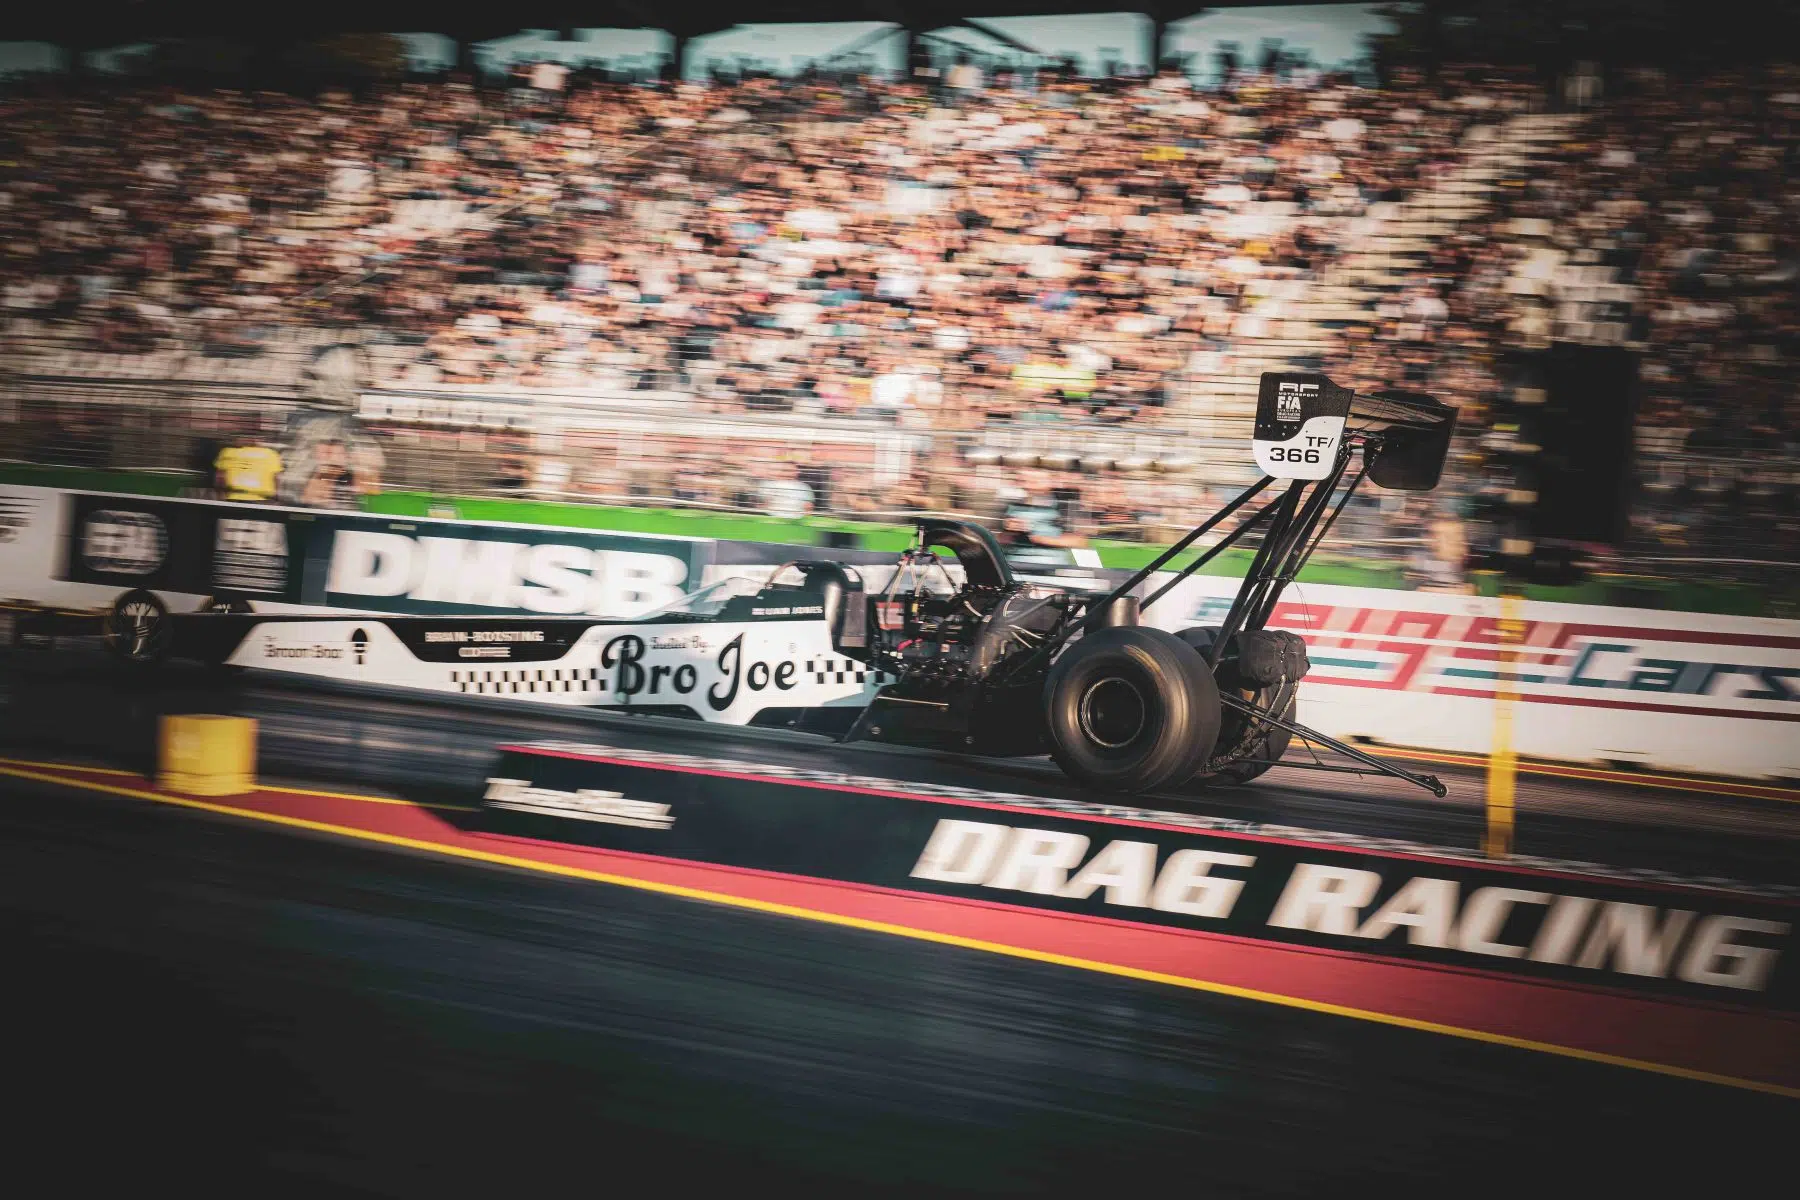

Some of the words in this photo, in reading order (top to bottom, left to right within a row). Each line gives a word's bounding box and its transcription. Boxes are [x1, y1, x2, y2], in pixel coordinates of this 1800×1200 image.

[1269, 447, 1320, 463] 366
[601, 634, 697, 695] Bro
[707, 631, 799, 712] Joe
[908, 818, 1258, 919] DRAG
[1266, 861, 1792, 991] RACING
